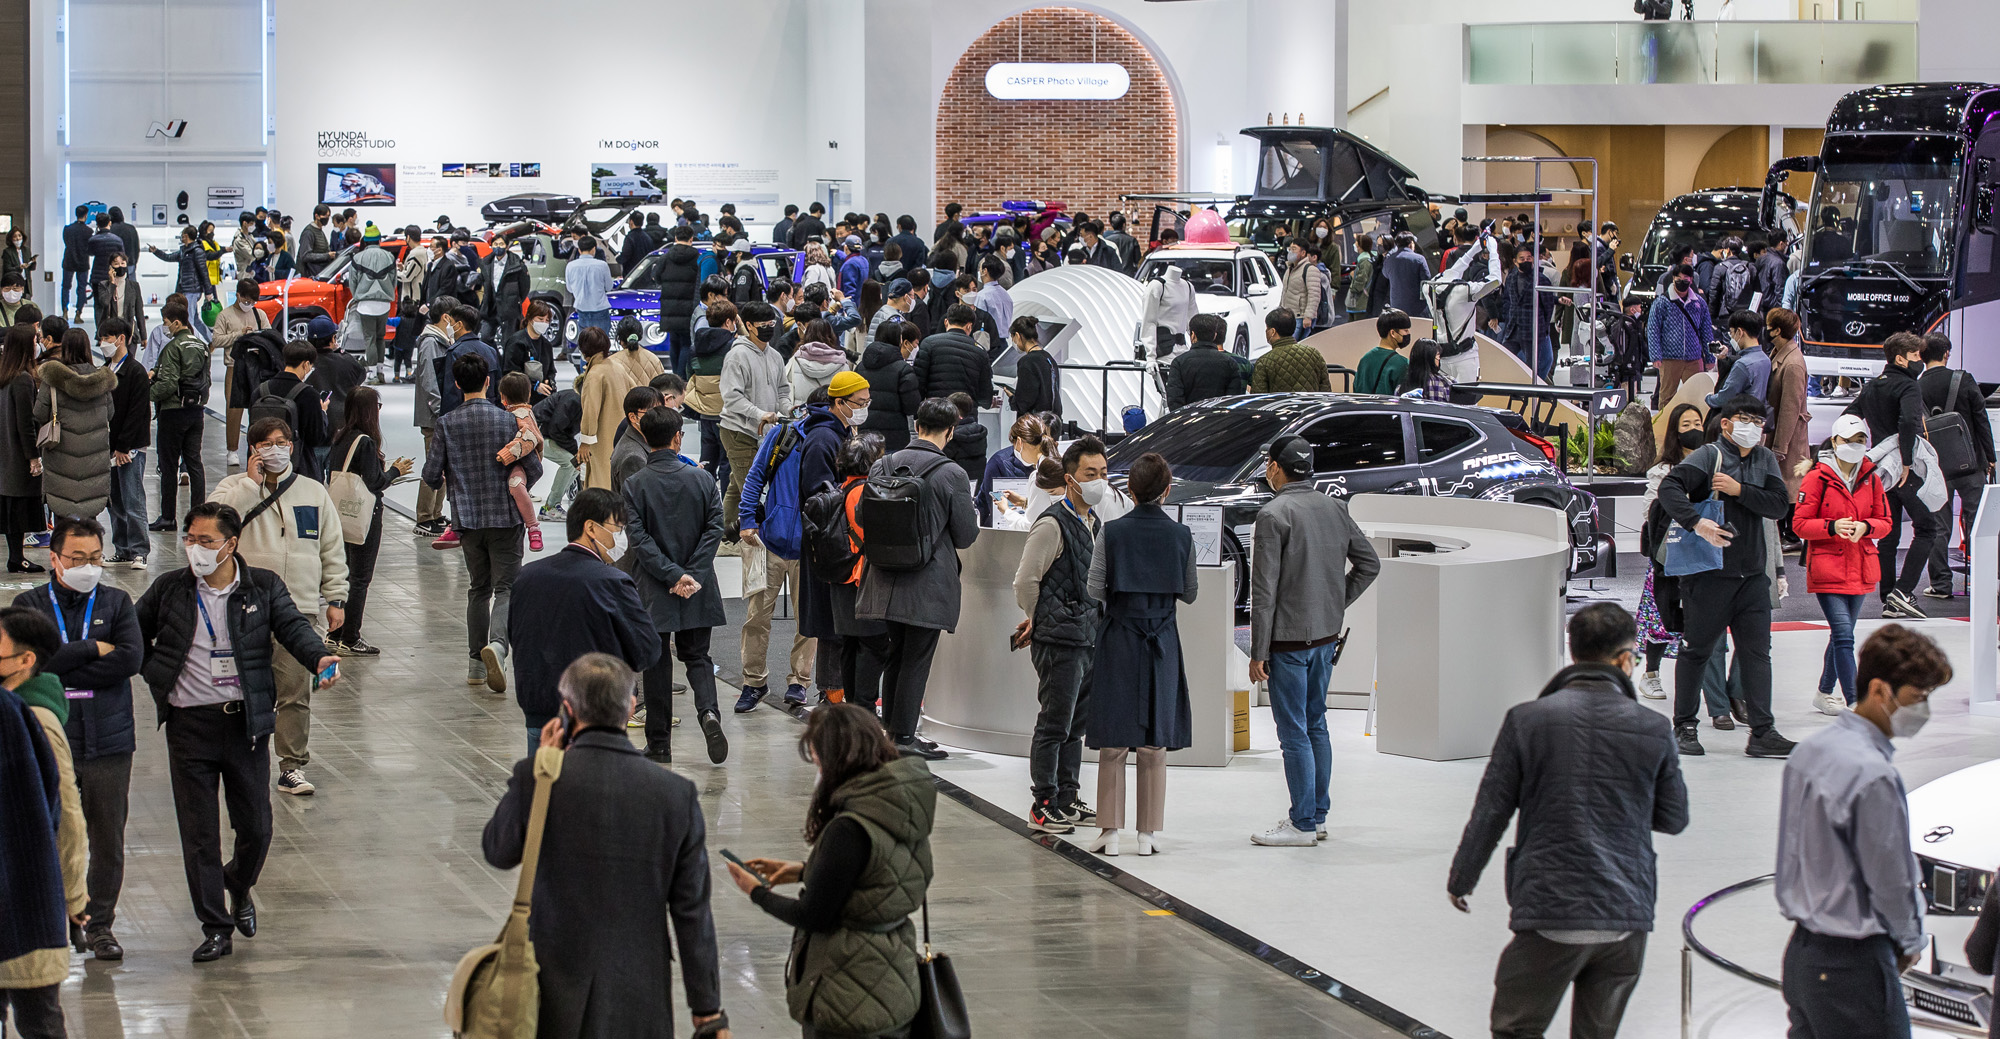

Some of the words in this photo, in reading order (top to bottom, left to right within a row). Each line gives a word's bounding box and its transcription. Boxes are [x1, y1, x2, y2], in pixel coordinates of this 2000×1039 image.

[1007, 77, 1045, 85] CASPER
[1047, 77, 1075, 85] Photo
[1077, 77, 1109, 86] Village
[318, 131, 367, 140] HYUNDAI
[318, 140, 396, 149] MOTORSTUDIO
[318, 148, 362, 157] GOYANG
[1847, 293, 1870, 301] MOBILE
[1870, 293, 1892, 302] OFFICE
[1899, 295, 1910, 303] 002
[338, 498, 362, 514] ECO
